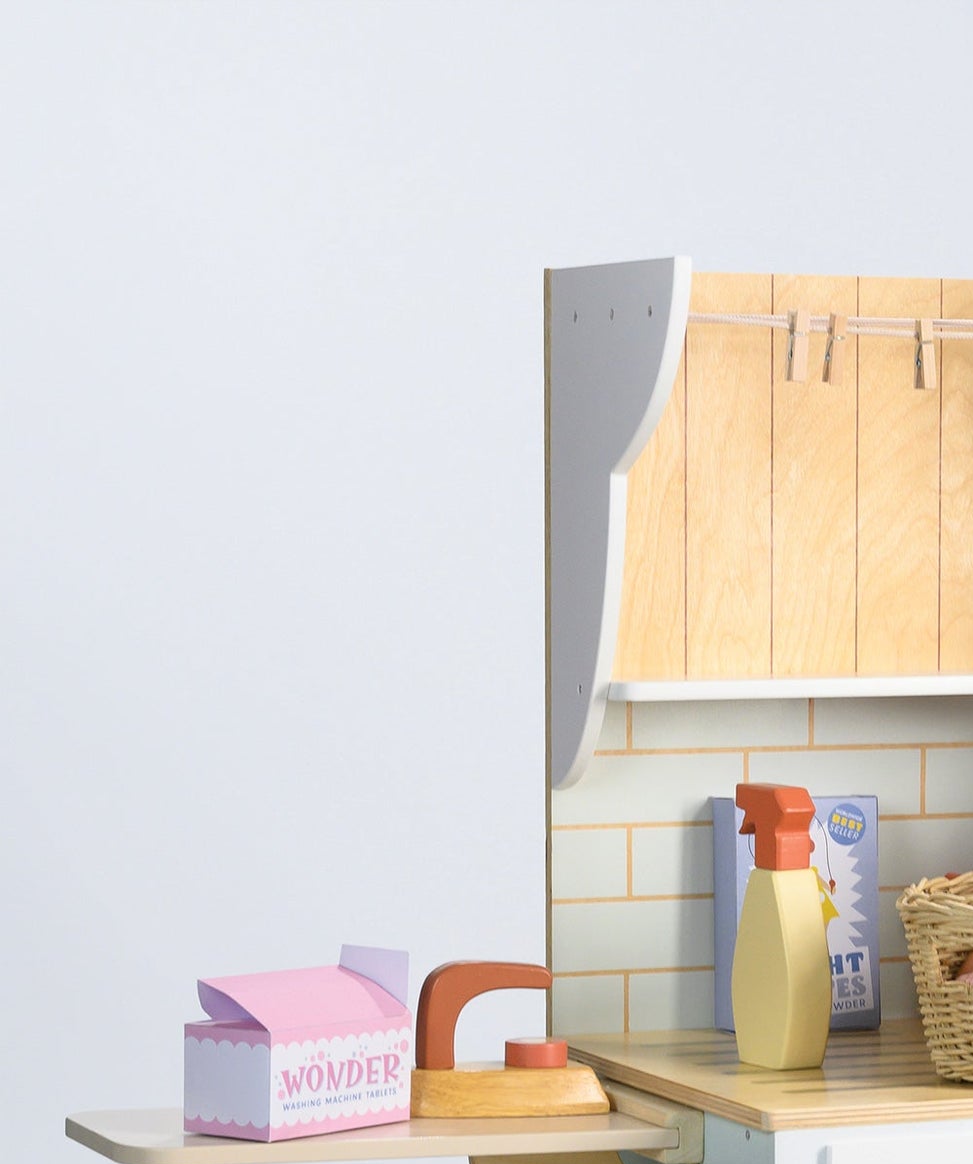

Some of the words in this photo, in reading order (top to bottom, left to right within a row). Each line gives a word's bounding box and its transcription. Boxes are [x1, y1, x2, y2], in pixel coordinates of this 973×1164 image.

[829, 823, 859, 840] SELLER
[830, 952, 864, 975] HT
[832, 975, 867, 998] ES
[833, 999, 866, 1011] WDER
[280, 1053, 401, 1099] WONDER
[282, 1098, 322, 1112] WASHING
[324, 1092, 362, 1105] MACHINE
[366, 1087, 398, 1099] TABLETS
